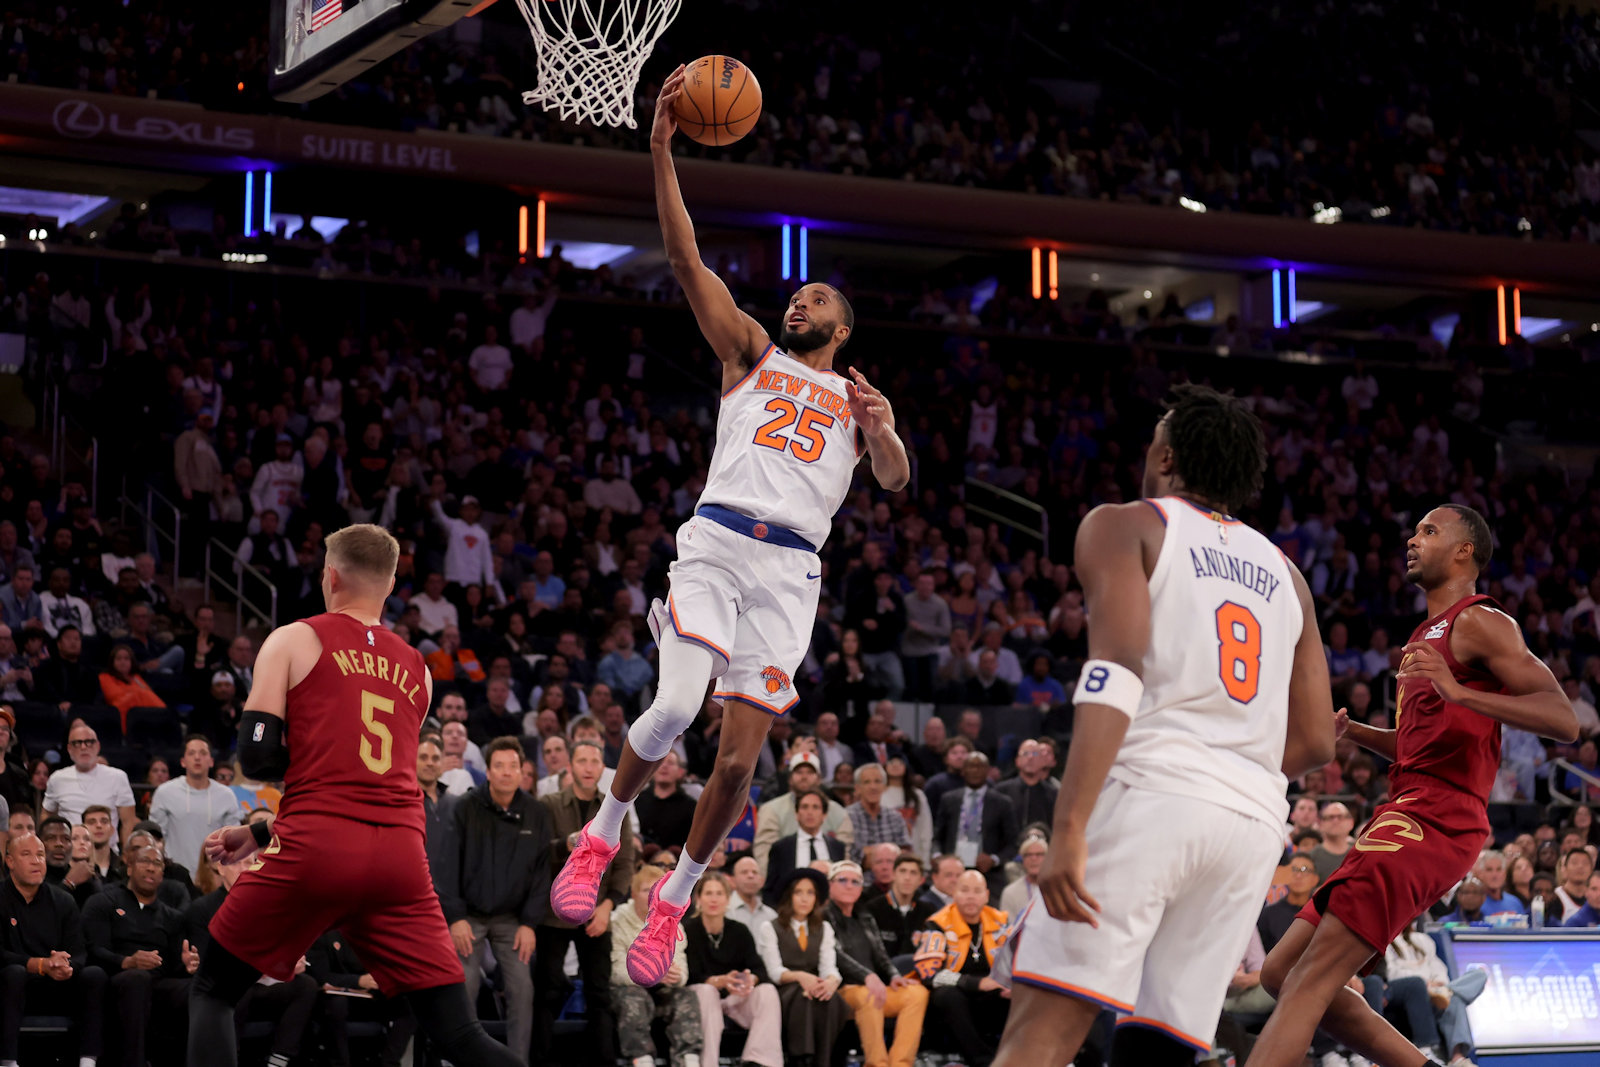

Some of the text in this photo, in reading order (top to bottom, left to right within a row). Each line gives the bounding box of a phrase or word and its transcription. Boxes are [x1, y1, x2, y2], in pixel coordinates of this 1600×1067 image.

[109, 113, 255, 149] LEXUS
[302, 134, 457, 172] SUITE LEVEL
[754, 369, 853, 430] NEW YORK
[752, 397, 836, 464] 25
[1189, 546, 1280, 603] ANUNOBY
[332, 649, 420, 705] MERRILL
[1085, 666, 1110, 692] 8
[1215, 600, 1262, 705] 8
[359, 689, 395, 775] 5
